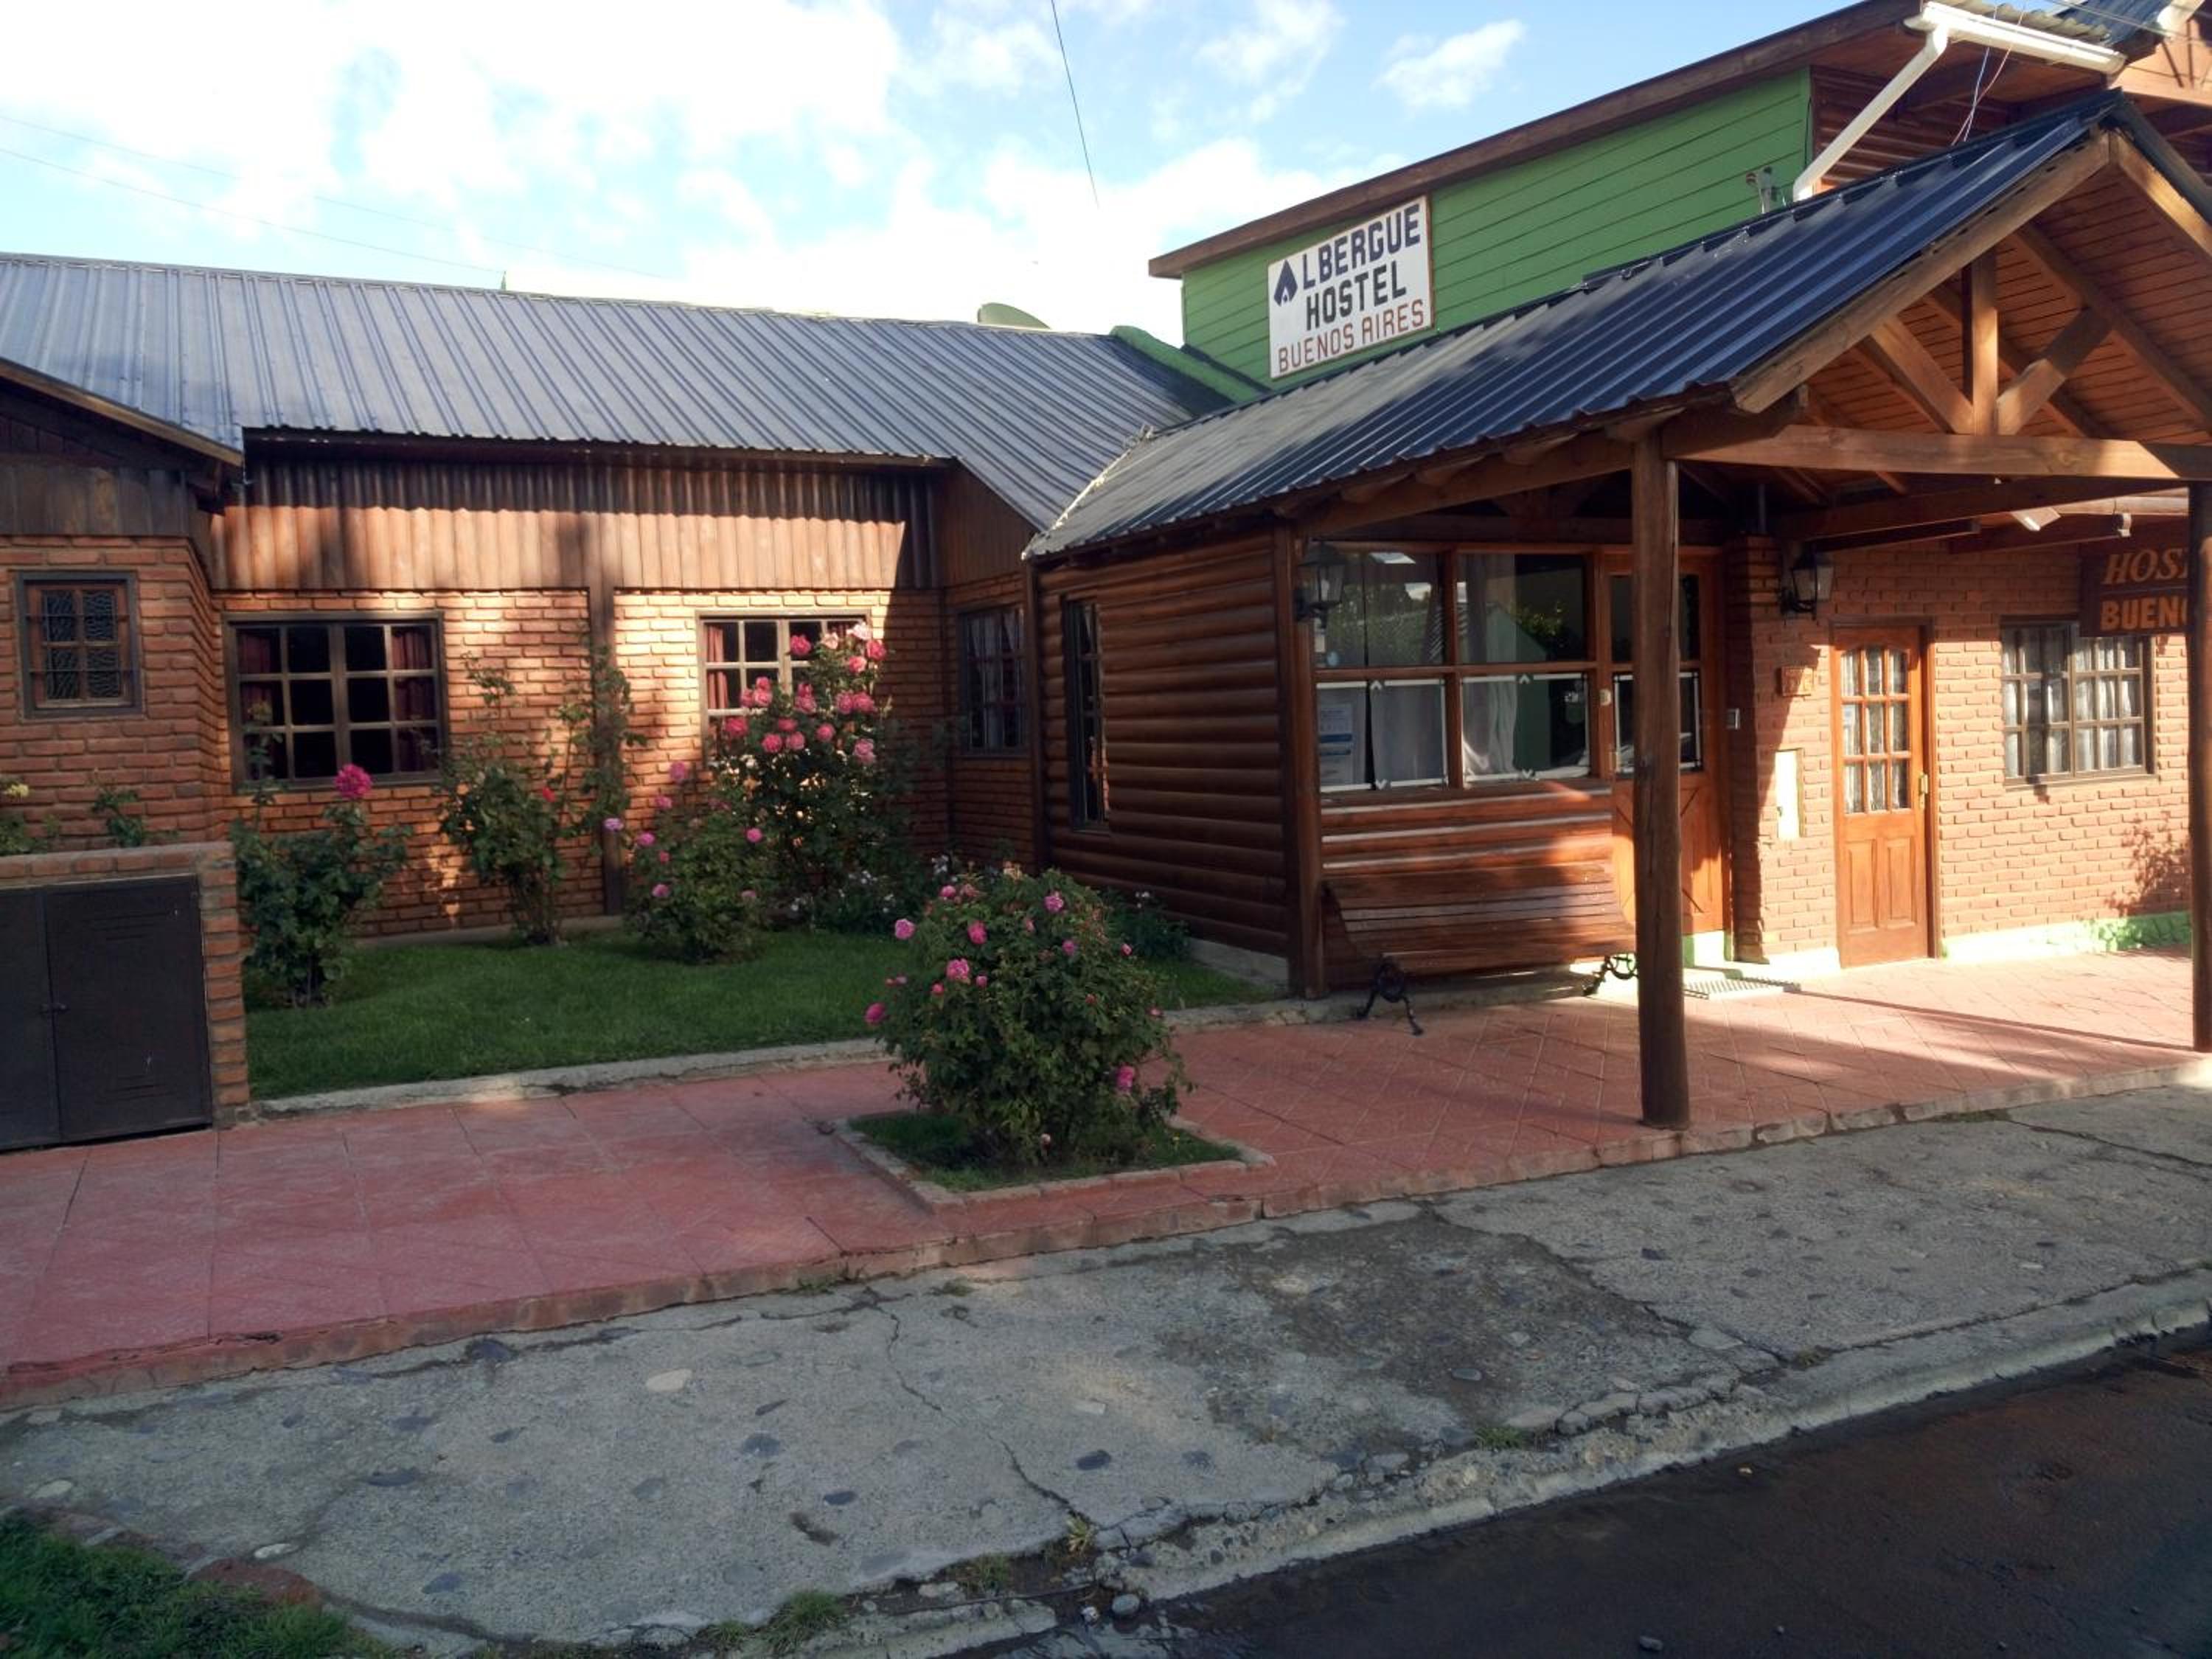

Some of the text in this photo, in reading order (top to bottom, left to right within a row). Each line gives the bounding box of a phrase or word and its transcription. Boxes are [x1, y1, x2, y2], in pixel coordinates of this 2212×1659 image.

[1306, 261, 1407, 331] HOSTEL
[1278, 299, 1424, 372] BUENOS AIRES
